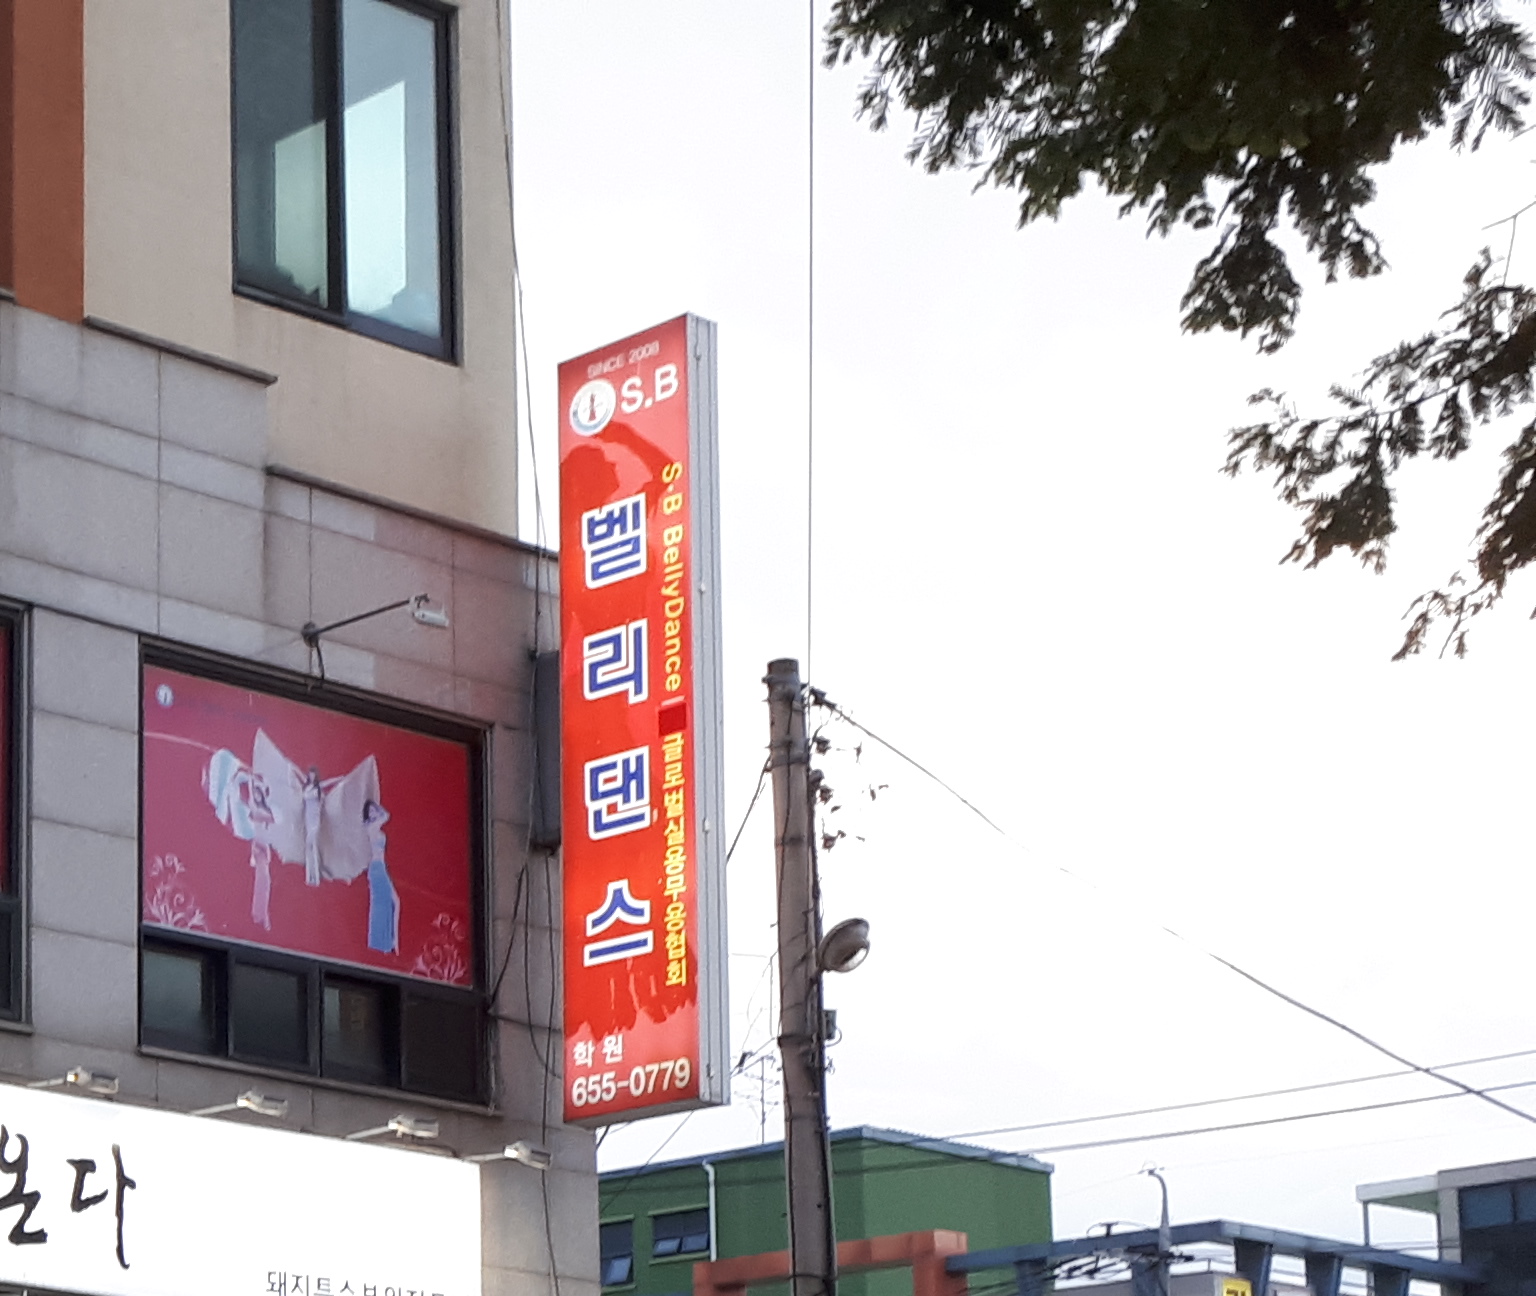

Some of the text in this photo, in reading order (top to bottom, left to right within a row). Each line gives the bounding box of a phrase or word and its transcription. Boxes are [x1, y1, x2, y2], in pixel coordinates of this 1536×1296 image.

[620, 363, 679, 413] S.B
[662, 524, 684, 693] BellyDance
[581, 491, 654, 968] 벨리댄스
[572, 1056, 691, 1108] 655-0779
